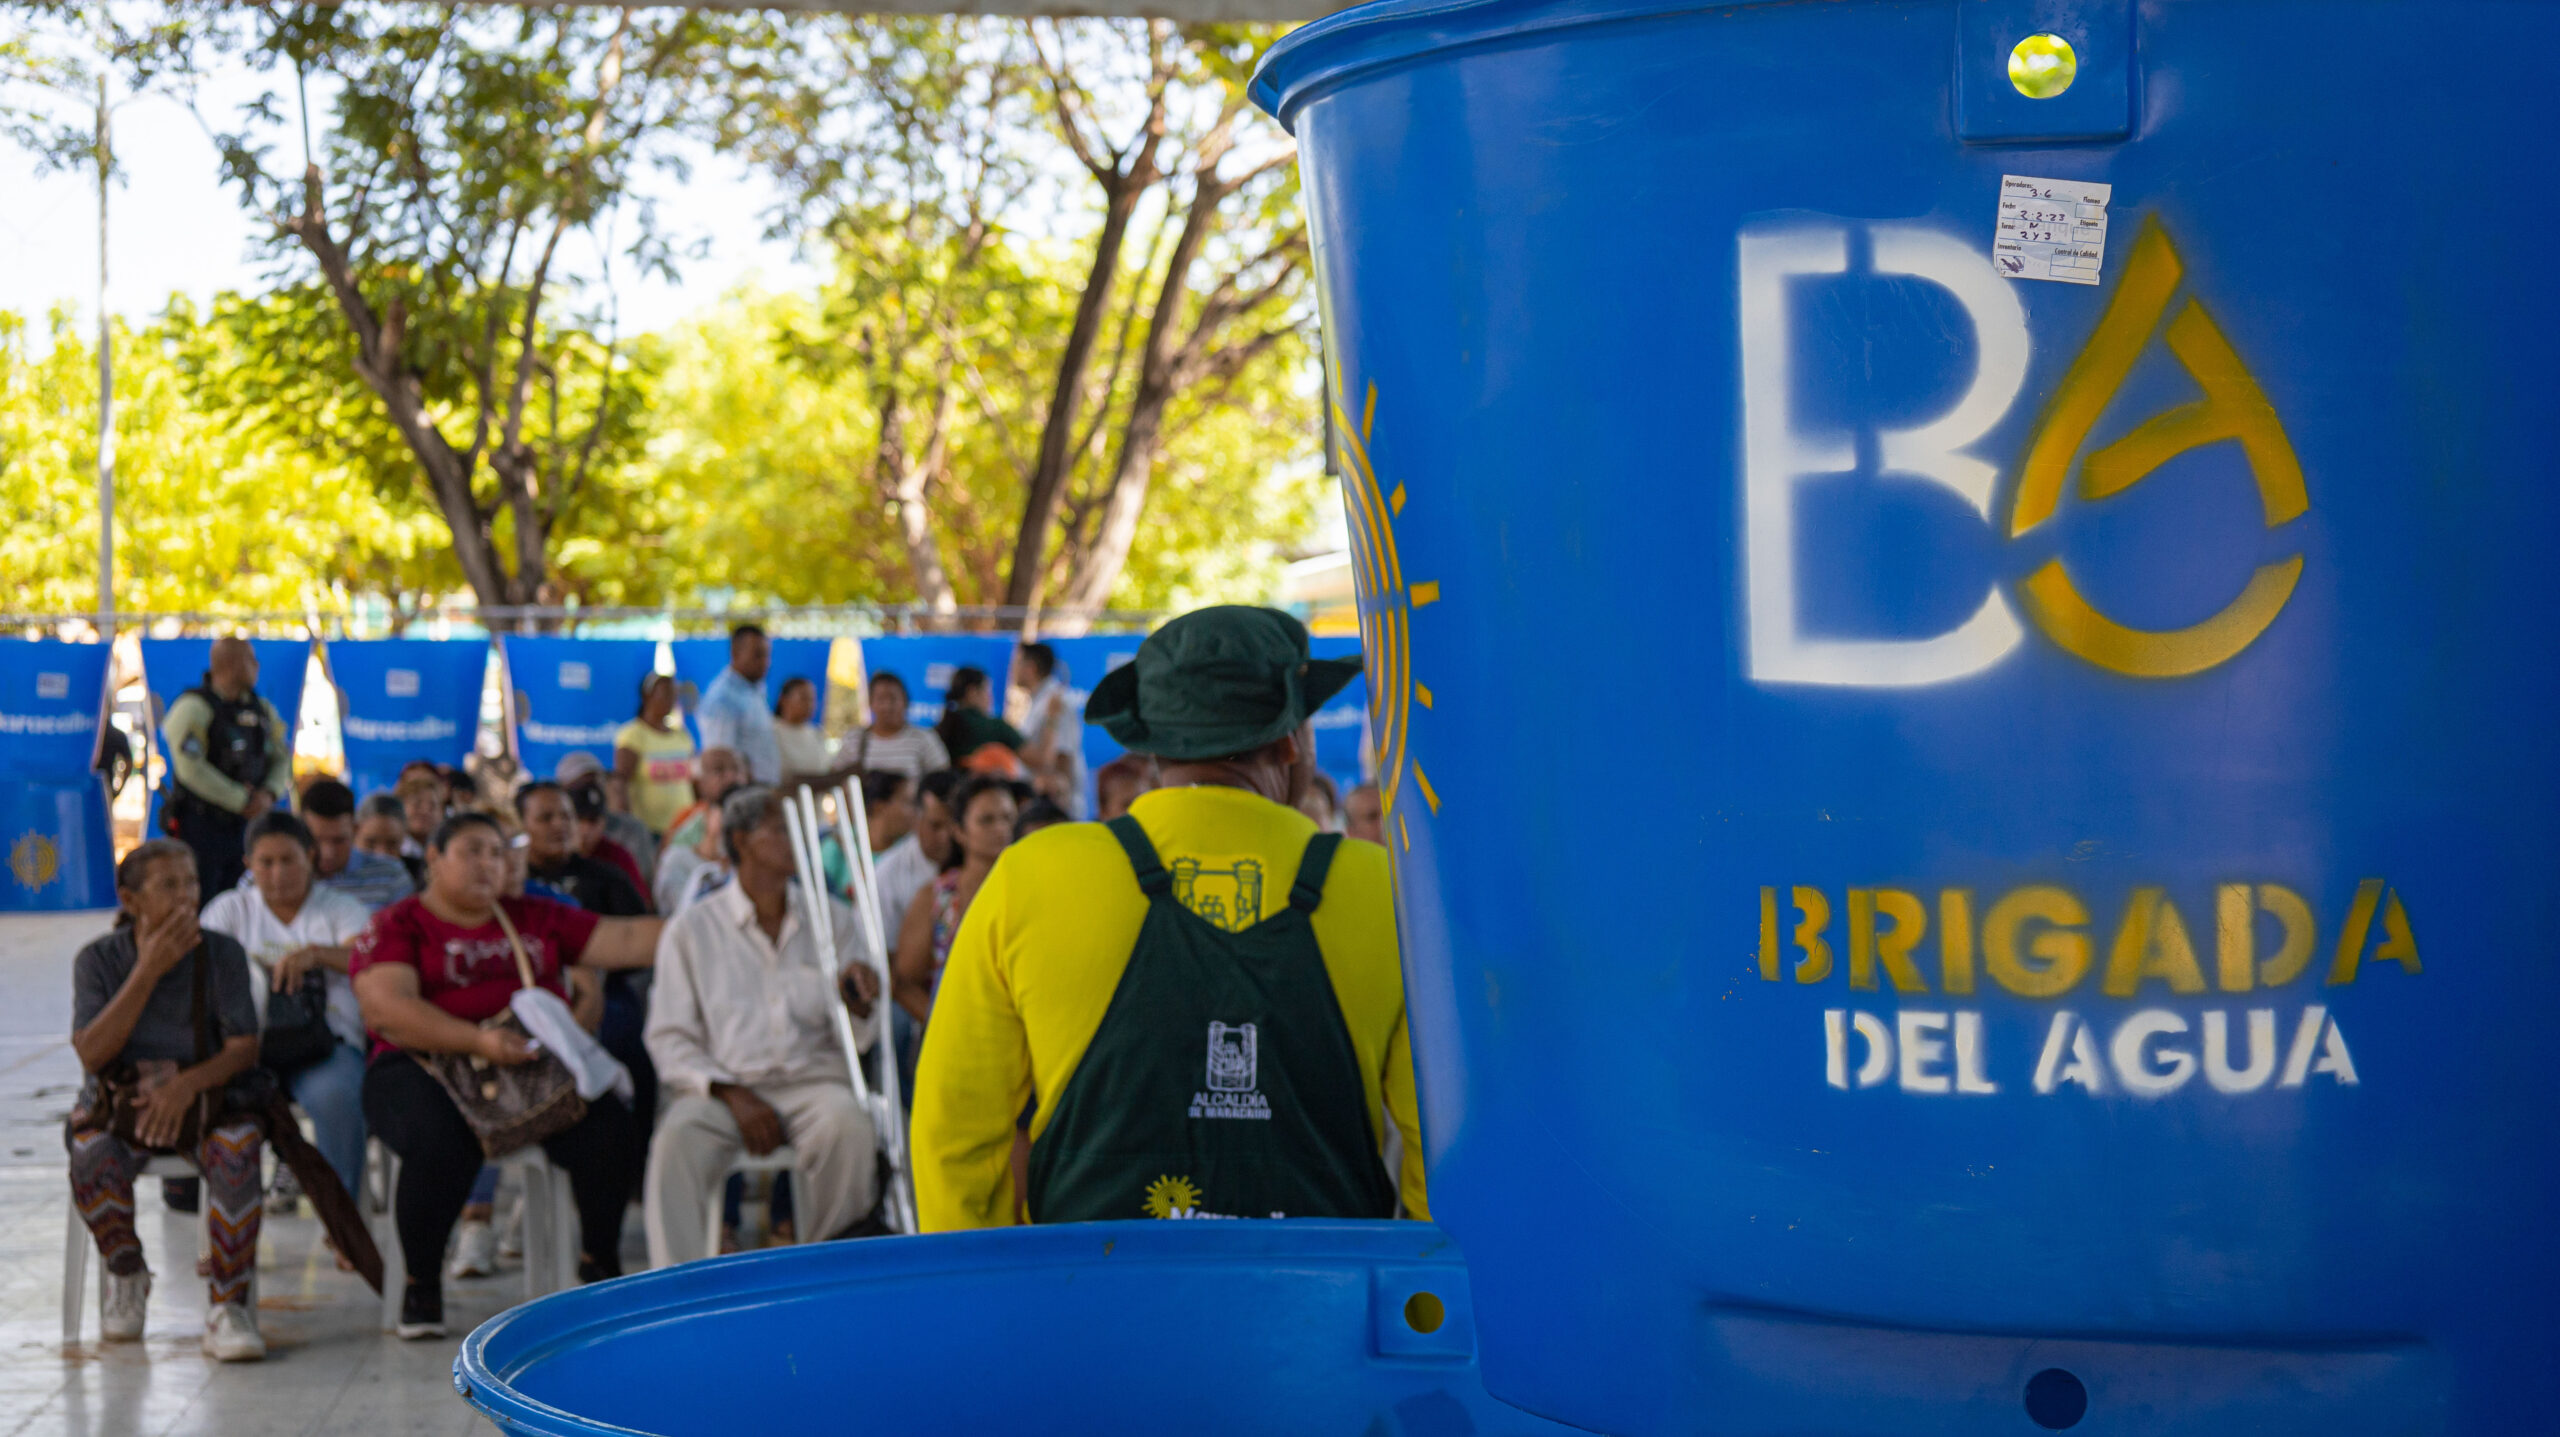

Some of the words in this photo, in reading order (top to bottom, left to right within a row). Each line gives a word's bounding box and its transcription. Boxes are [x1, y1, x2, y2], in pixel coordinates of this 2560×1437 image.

[2044, 232, 2052, 241] 3
[1997, 242, 2022, 251] Inventario
[2054, 247, 2072, 256] Control
[2072, 249, 2079, 257] de
[2079, 250, 2098, 258] Calidad
[1759, 877, 2424, 997] BRIGADA
[1824, 1008, 1998, 1094] DEL
[2033, 1006, 2360, 1095] AGUA
[1191, 1090, 1269, 1108] ALCALDÍA
